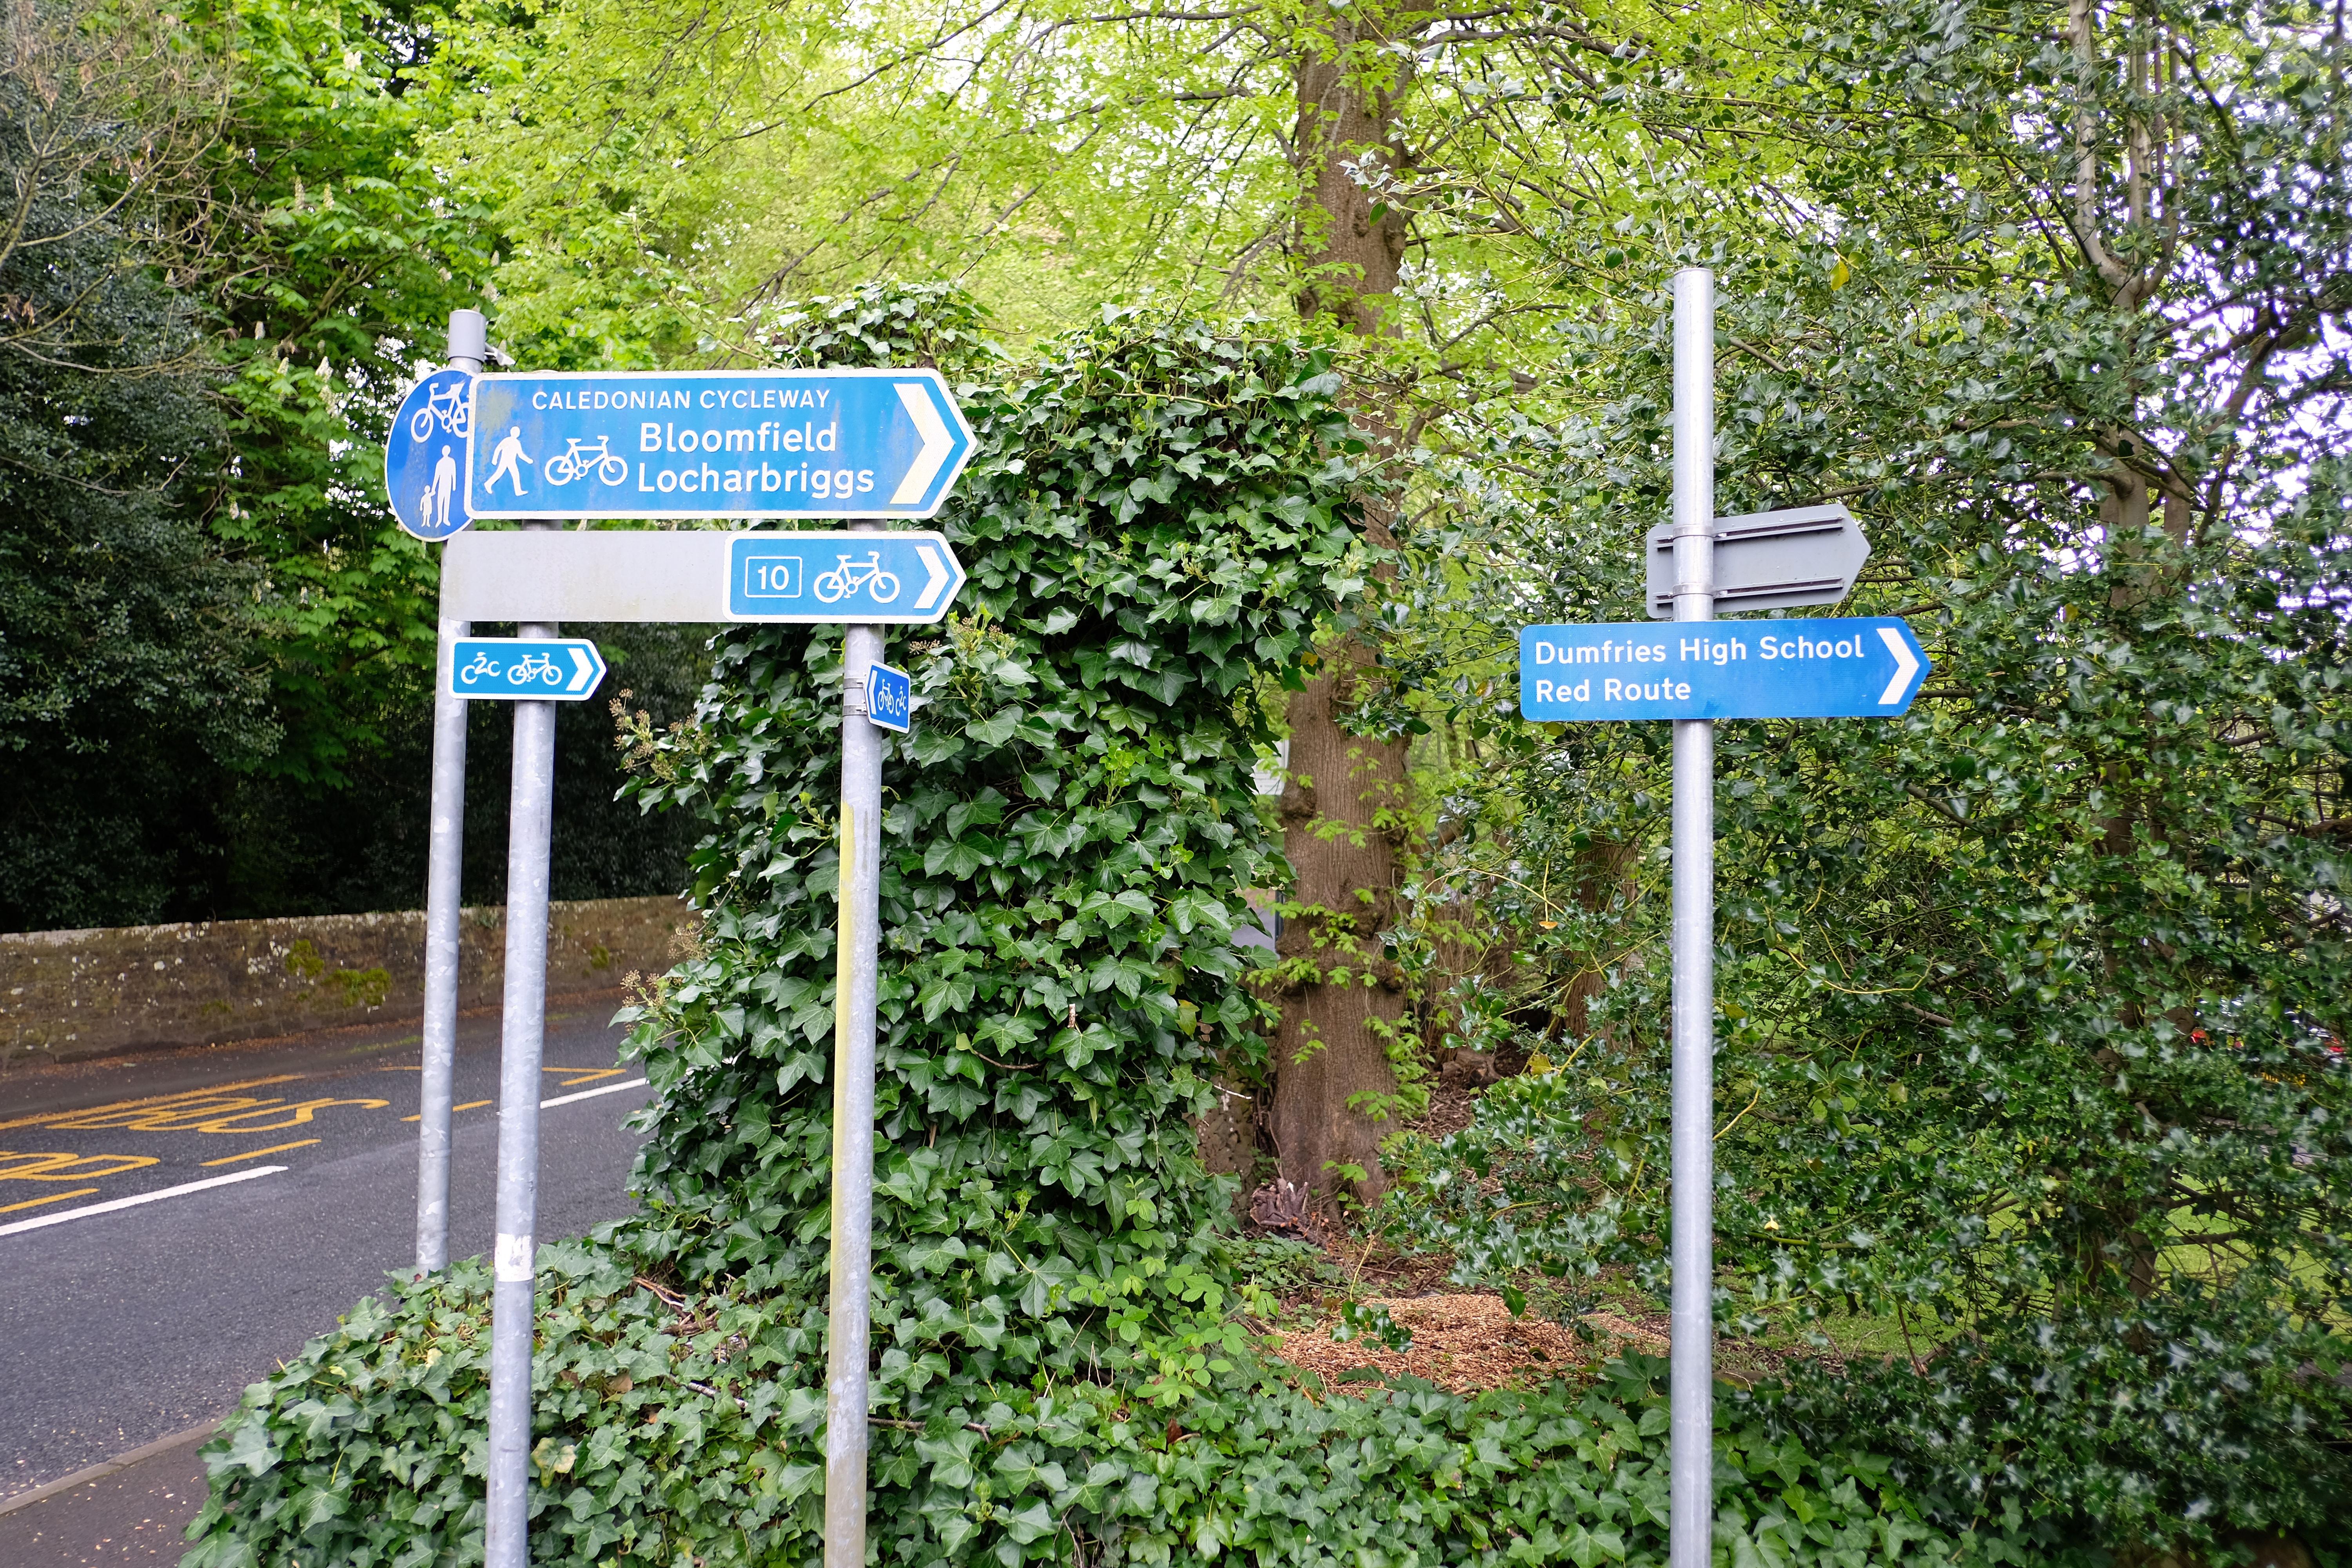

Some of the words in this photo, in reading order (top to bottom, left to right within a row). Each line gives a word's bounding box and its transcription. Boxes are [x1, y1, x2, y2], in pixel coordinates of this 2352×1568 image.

[532, 389, 691, 410] CALEDONIAN
[700, 389, 830, 409] CYCLEWAY
[640, 421, 838, 452] Bloomfield
[638, 462, 875, 499] Locharbriggs
[757, 565, 789, 590] 10
[1535, 640, 1666, 664] Dumfries
[1680, 637, 1746, 666] High
[1759, 634, 1864, 660] School
[1536, 679, 1590, 702] Red
[1604, 677, 1691, 701] Route
[45, 1098, 390, 1133] BUS
